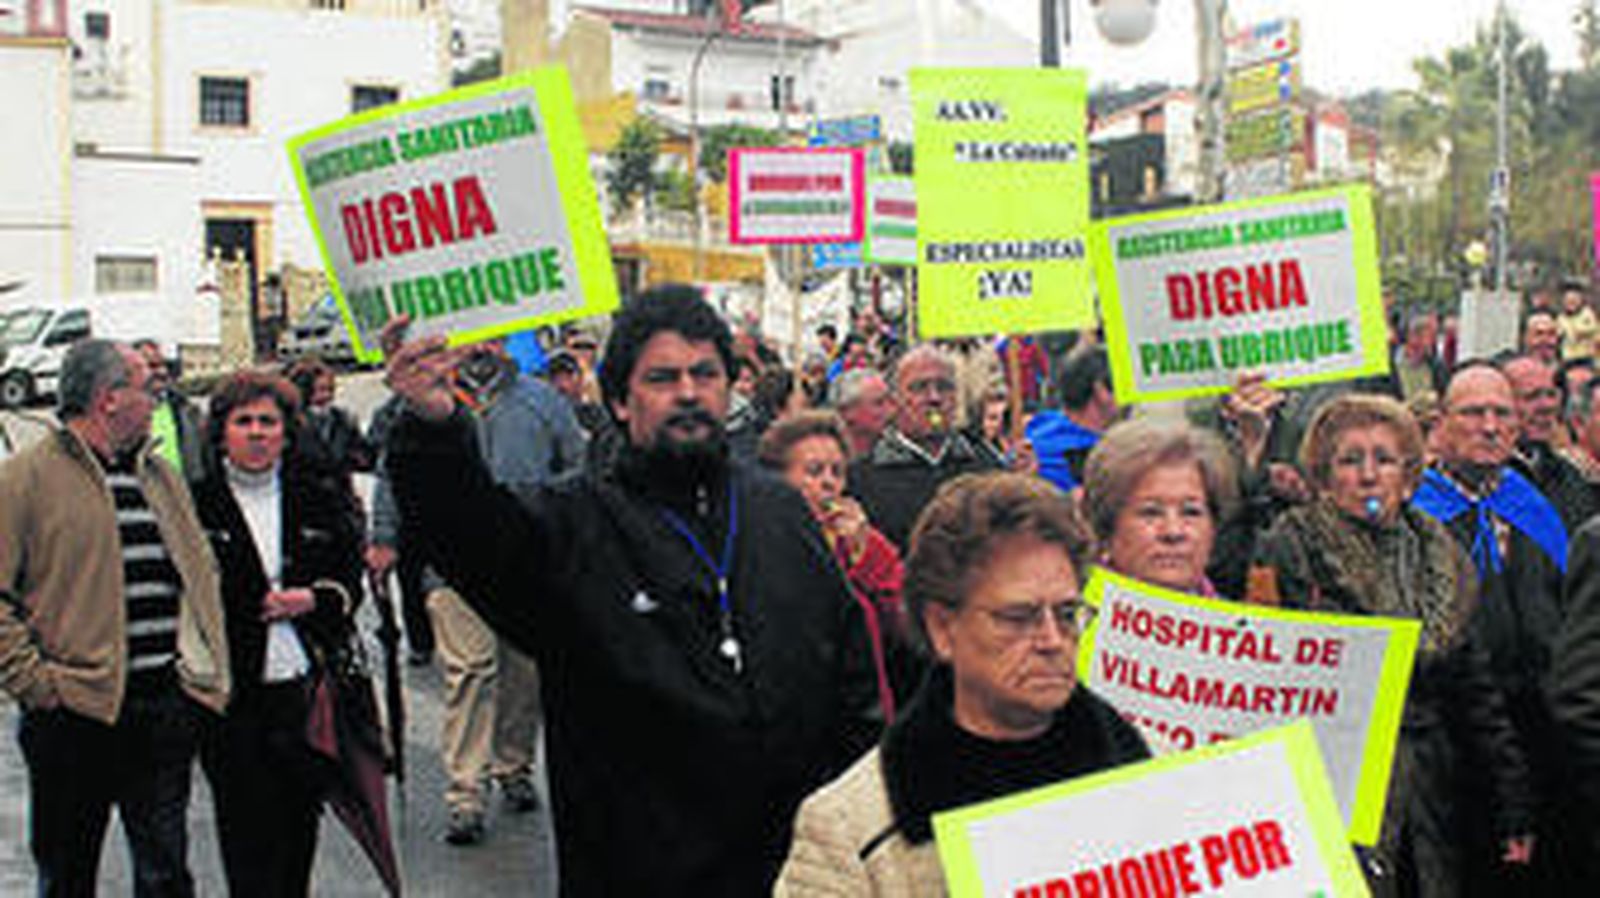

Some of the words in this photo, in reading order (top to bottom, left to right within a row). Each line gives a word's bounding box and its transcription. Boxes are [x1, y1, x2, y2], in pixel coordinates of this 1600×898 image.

[398, 105, 536, 161] SANITARIA
[341, 174, 496, 266] DIGNA
[391, 247, 564, 323] UBRIQUE
[978, 271, 1033, 300] ¡YA!
[1165, 258, 1309, 321] DIGNA
[1139, 338, 1216, 377] PARA
[1217, 319, 1354, 371] UBRIQUE
[1110, 602, 1284, 664] HOSPITAL
[1293, 637, 1345, 668] DE
[1101, 650, 1340, 716] VILLAMARTIN
[1200, 820, 1293, 889] POR
